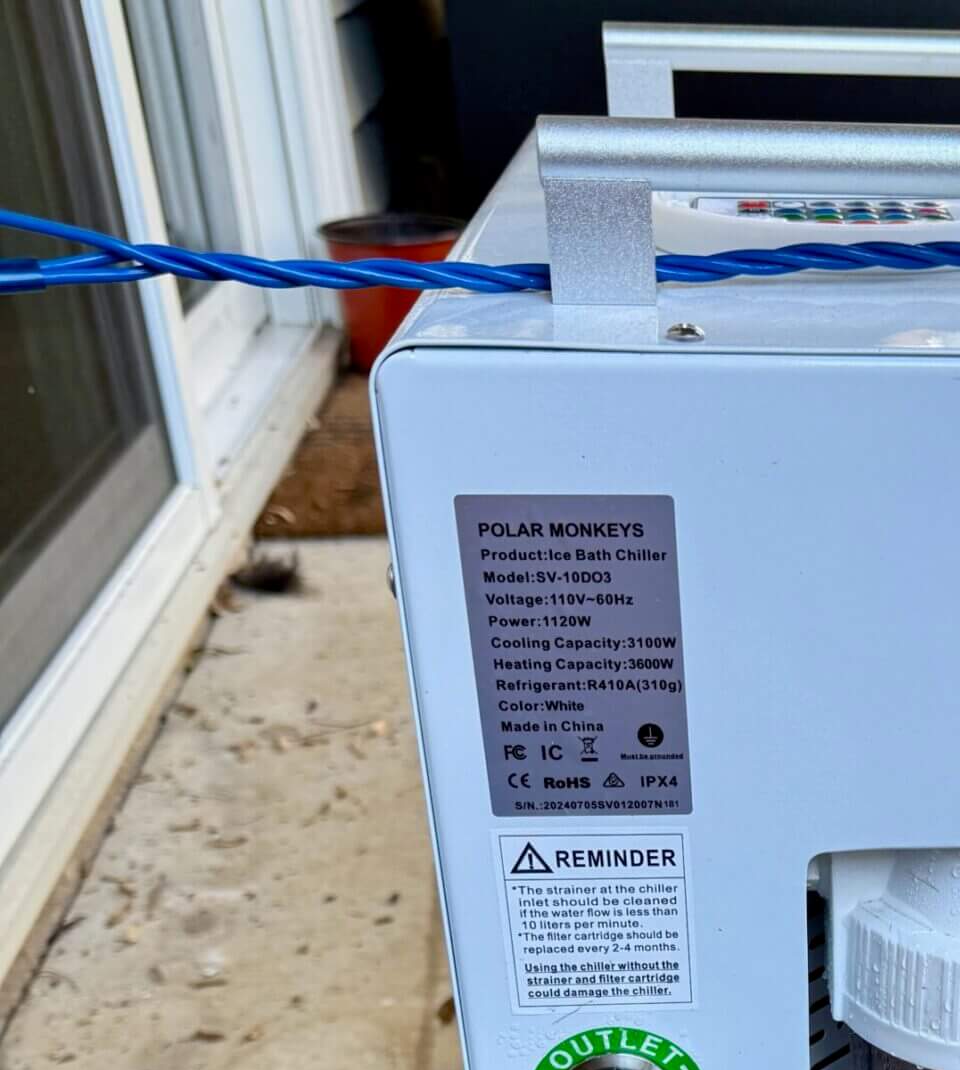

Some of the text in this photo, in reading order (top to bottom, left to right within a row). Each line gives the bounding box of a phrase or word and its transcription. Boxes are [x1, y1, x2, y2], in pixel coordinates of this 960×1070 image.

[478, 523, 645, 538] POLAR MONKEYS
[481, 548, 668, 561] Product:Ice Bath Chiller
[485, 593, 634, 608] Voltage:110V~60Hz
[488, 615, 592, 627] Power:1120W
[490, 637, 677, 651] Cooling Capacity:3100W
[493, 658, 674, 673] Heating Capacity:3600W
[496, 679, 682, 694] Refrigerant:R410A(310g)
[498, 700, 585, 712] Color:White
[501, 721, 604, 732] Made in China
[541, 745, 563, 760] IC
[507, 773, 678, 789] CE RoHS IPX4
[555, 849, 677, 868] REMINDER
[546, 885, 596, 895] strainer
[600, 885, 612, 894] at
[615, 884, 636, 894] the
[638, 884, 678, 894] chiller
[519, 895, 678, 907] inlet should be cleaned
[520, 907, 678, 918] if the water flow is less than
[522, 919, 644, 931] 10 liters per minute.
[547, 931, 572, 941] filter
[574, 931, 624, 943] cartridge
[626, 930, 663, 940] should
[665, 930, 679, 939] be
[523, 943, 680, 956] replaced every 2-4 months.
[524, 961, 679, 974] Using the chiller without the
[527, 974, 680, 986] strainer and filter cartridge
[528, 986, 672, 999] could damage the chiller.
[550, 1028, 683, 1070] OUTLET
